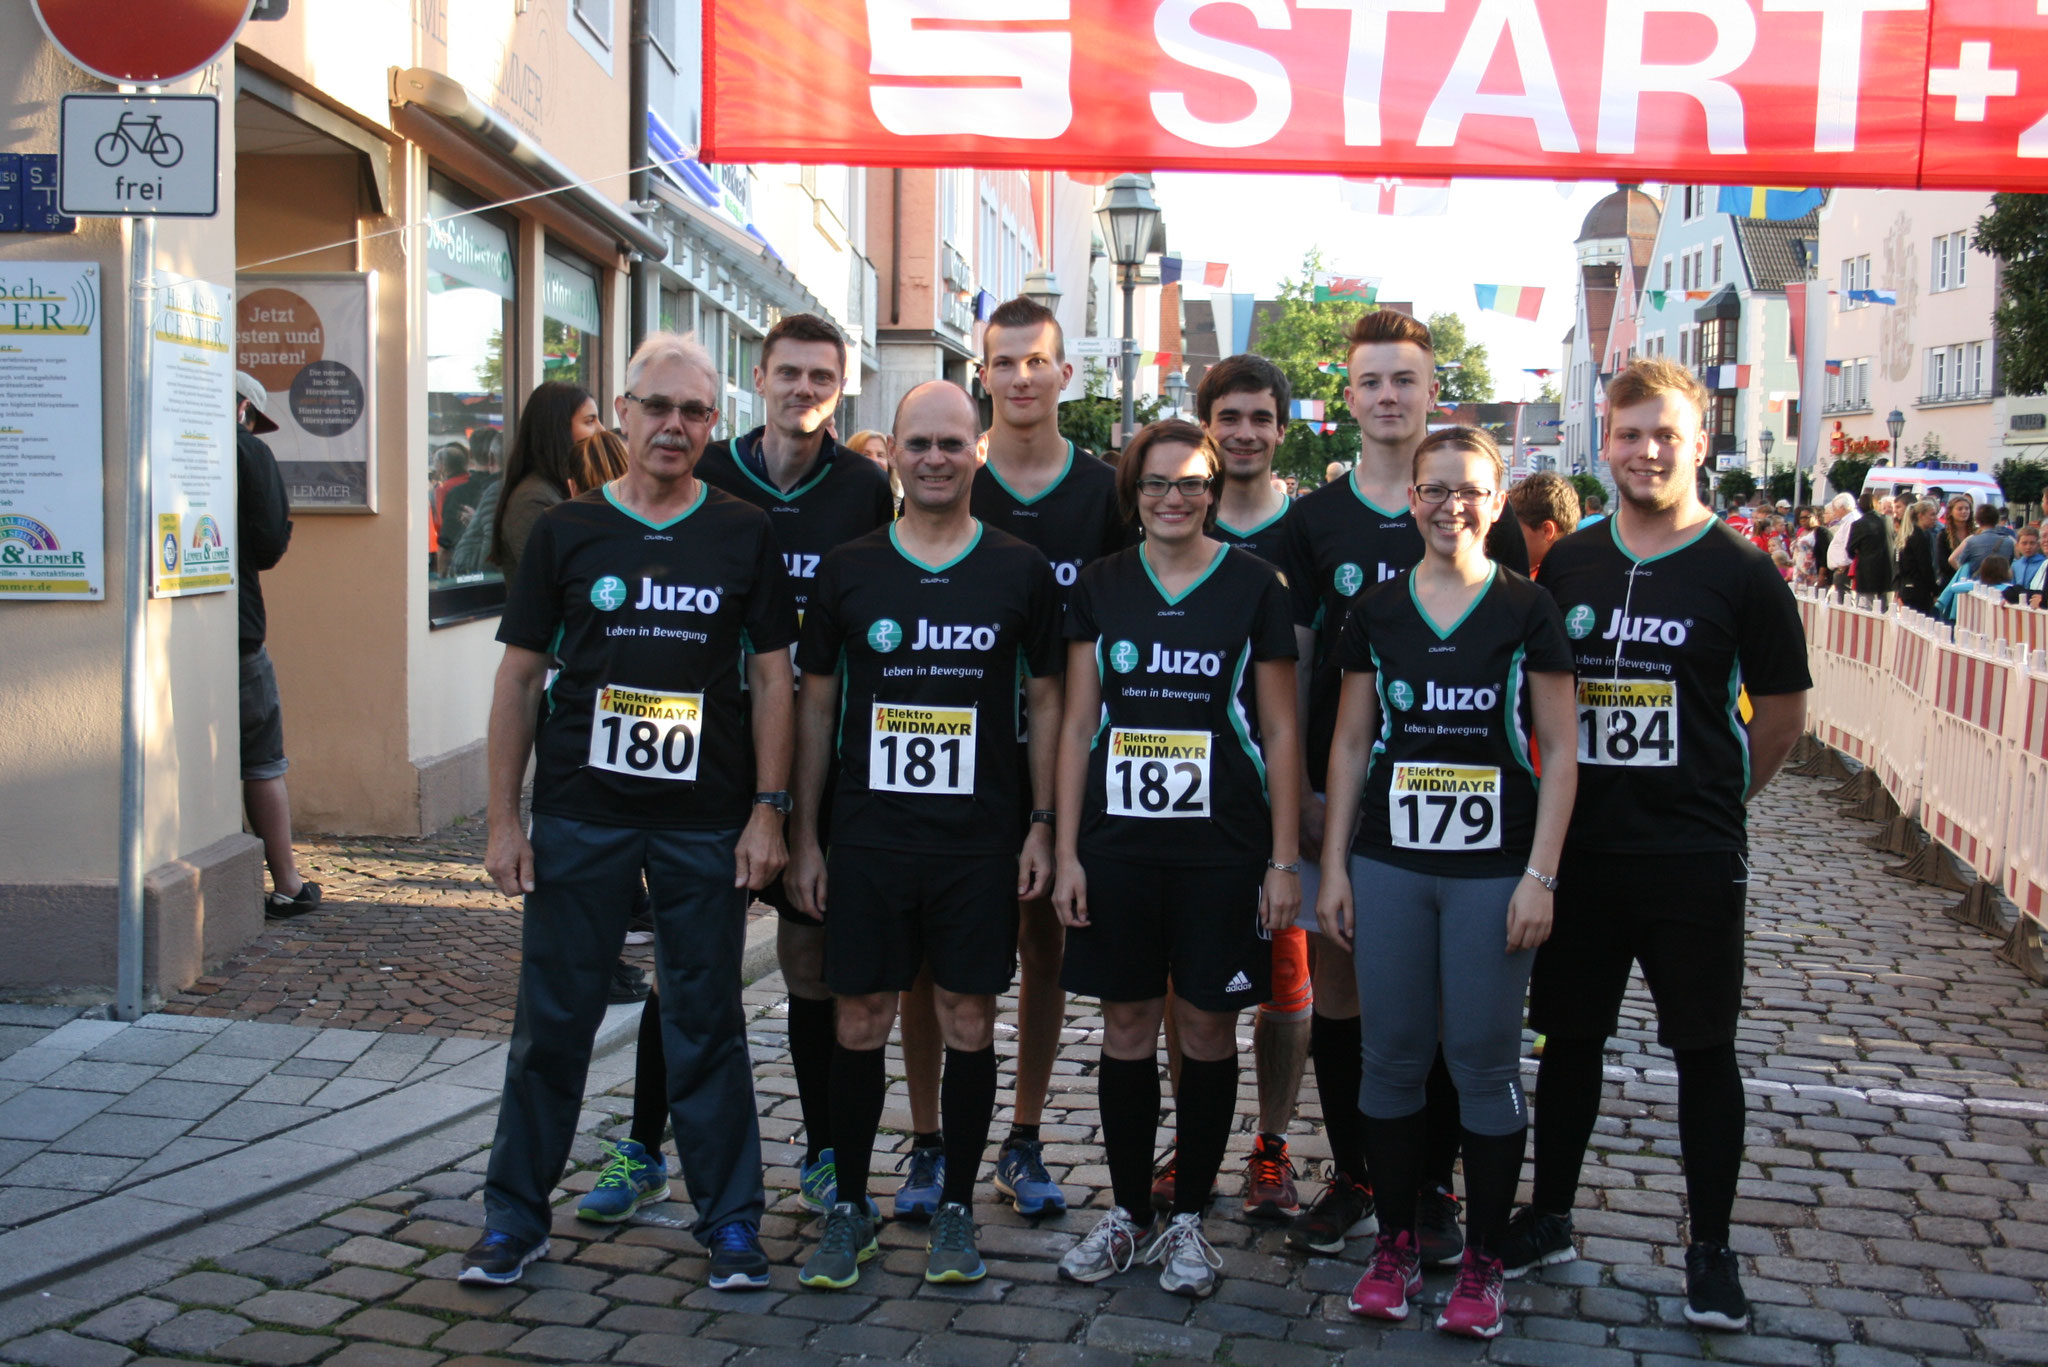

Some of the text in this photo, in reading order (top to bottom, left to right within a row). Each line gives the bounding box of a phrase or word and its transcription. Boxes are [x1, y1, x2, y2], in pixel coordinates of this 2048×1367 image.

[115, 176, 163, 200] frei
[0, 303, 67, 331] ER
[249, 307, 296, 323] Jetzt
[165, 312, 223, 347] CENTER
[285, 327, 321, 344] und
[240, 350, 306, 368] sparen!
[293, 485, 351, 498] LEMMER
[2, 545, 85, 564] & LEMMER
[606, 625, 708, 643] Leben in Bewegung
[883, 666, 984, 679] Leben in Bewegung
[1605, 656, 1616, 666] in
[1618, 657, 1672, 675] Bewegung
[613, 690, 662, 704] Elektro
[1150, 688, 1159, 697] in
[1162, 688, 1211, 702] Bewegung
[1587, 694, 1673, 707] WIDMAYR
[613, 701, 697, 721] WIDMAYR
[887, 708, 933, 720] Elektro
[887, 720, 972, 736] WIDMAYR
[1404, 723, 1488, 737] Leben in Bewegung
[1580, 709, 1675, 761] 184
[602, 716, 695, 775] 180
[1123, 732, 1167, 744] Elektro
[1124, 744, 1206, 760] WIDMAYR
[879, 735, 960, 788] 181
[1407, 766, 1455, 778] Elektro
[1115, 760, 1204, 813] 182
[1407, 778, 1496, 793] WIDMAYR
[1398, 794, 1494, 845] 179
[1225, 982, 1252, 992] adidas
